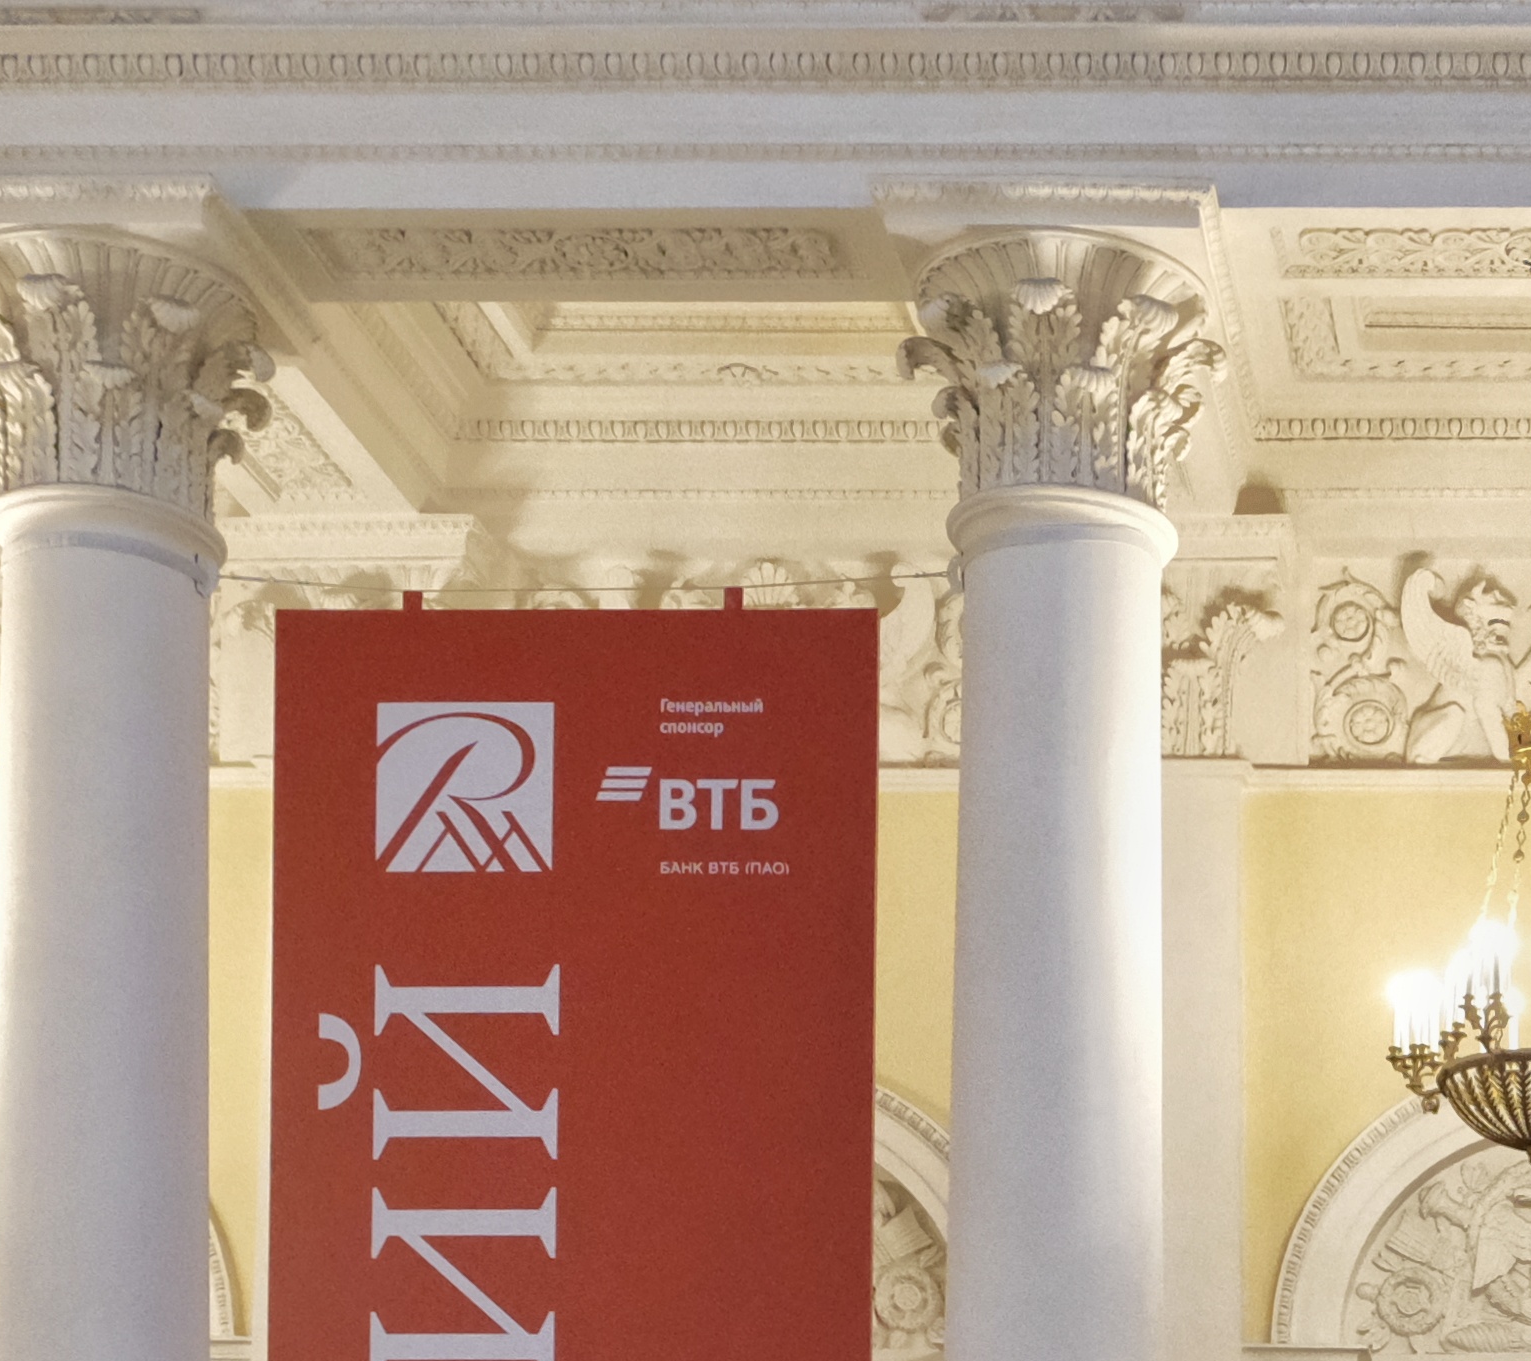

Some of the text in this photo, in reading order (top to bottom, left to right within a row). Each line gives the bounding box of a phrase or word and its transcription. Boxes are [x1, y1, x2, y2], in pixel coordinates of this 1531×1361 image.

[660, 698, 764, 717] Генеральный
[659, 721, 724, 738] спонсор
[658, 778, 780, 831] ВТБ
[659, 861, 790, 876] БАНК ВТБ (ПАО)
